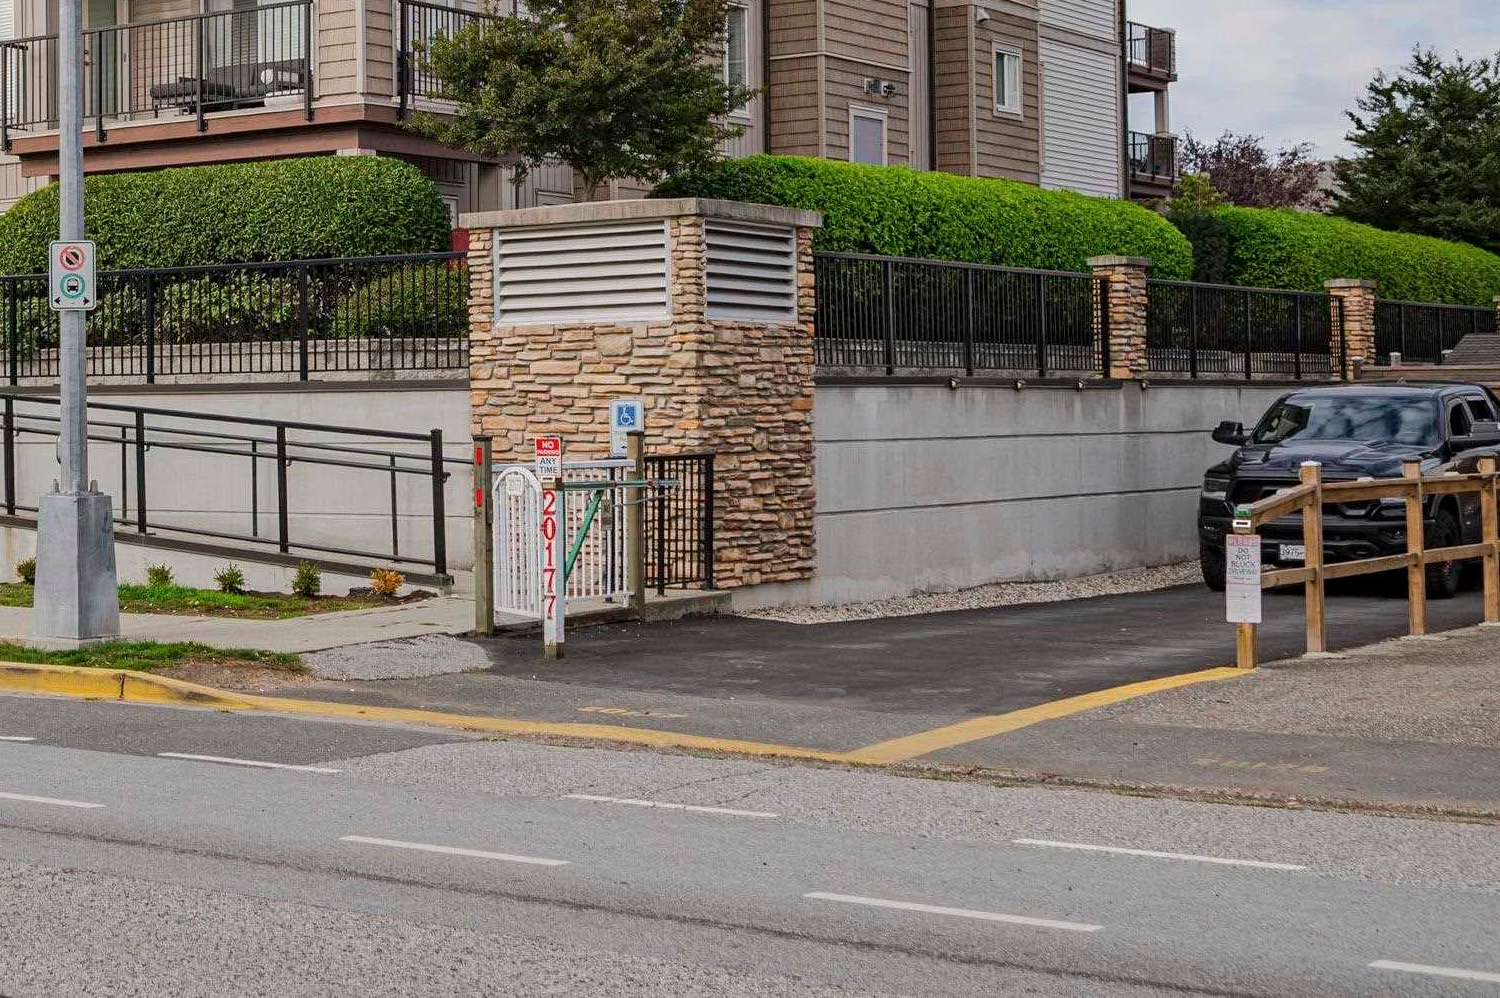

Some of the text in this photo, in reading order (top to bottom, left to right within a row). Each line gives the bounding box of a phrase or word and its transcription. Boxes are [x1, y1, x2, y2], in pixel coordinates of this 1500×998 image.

[541, 440, 555, 449] NO
[540, 457, 557, 465] ANY
[540, 466, 558, 474] TIME
[542, 490, 556, 619] 20177
